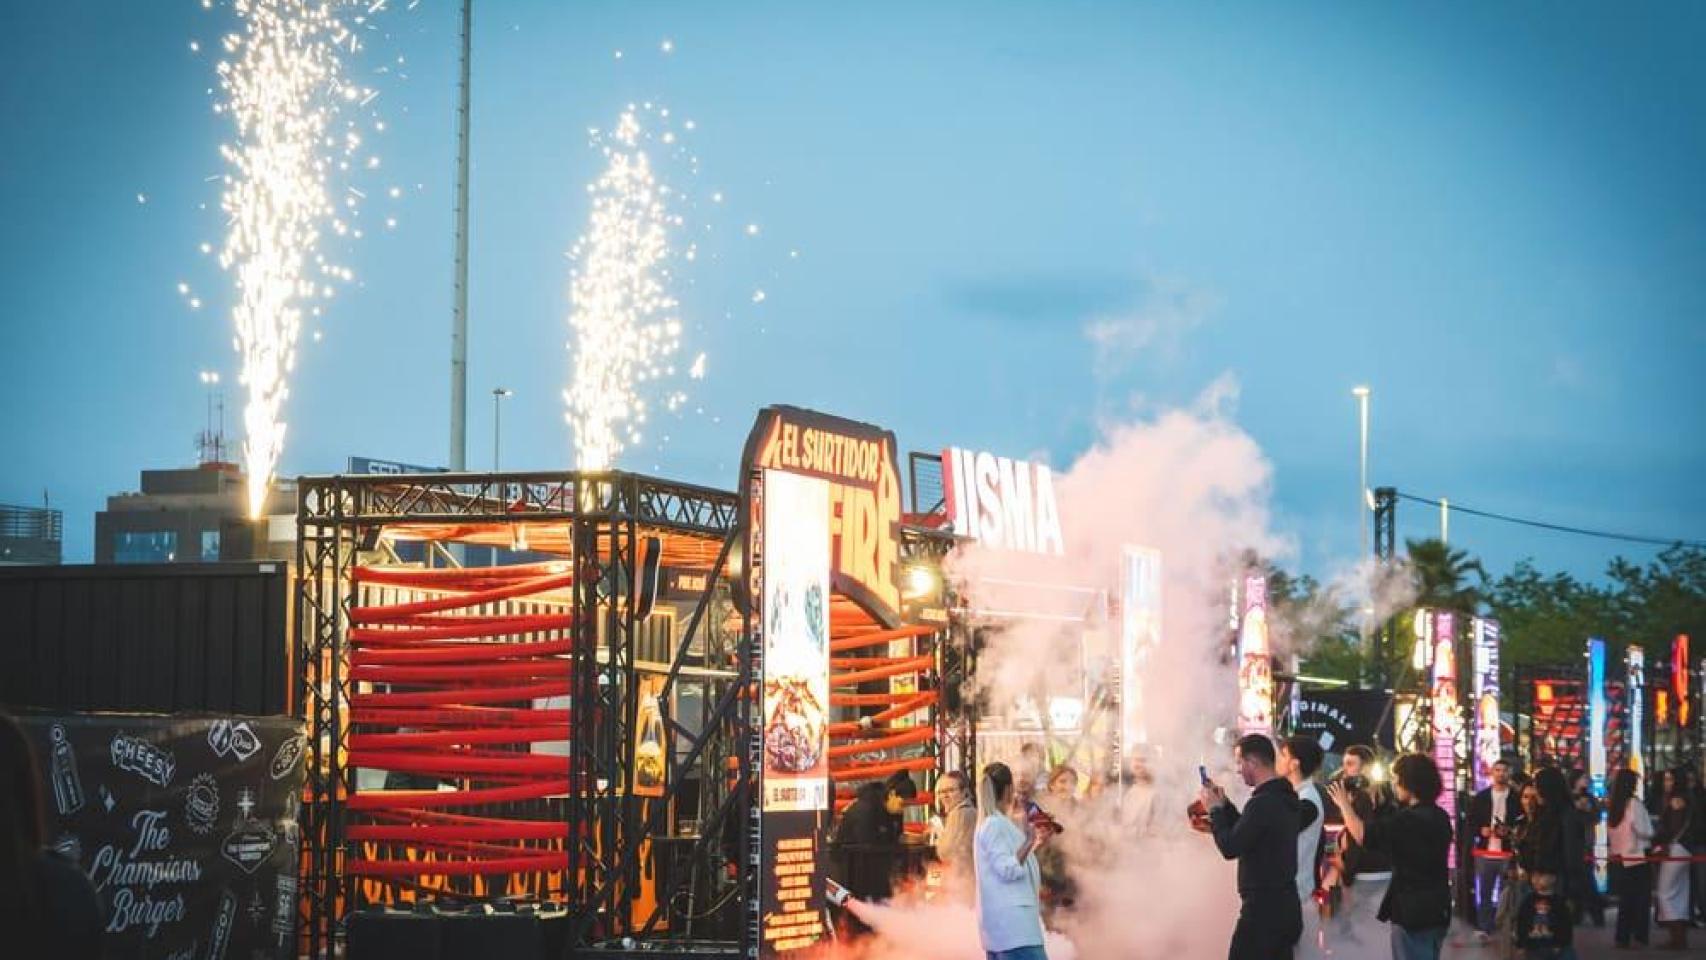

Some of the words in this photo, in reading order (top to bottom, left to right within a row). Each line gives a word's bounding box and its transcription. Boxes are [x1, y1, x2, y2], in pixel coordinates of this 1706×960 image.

[783, 423, 801, 468] EL
[803, 428, 880, 482] SURTIDOR
[829, 470, 900, 613] FIRE
[114, 738, 175, 781] CHEESY
[132, 809, 170, 859] The
[87, 845, 202, 893] Champions
[105, 888, 184, 938] Burger
